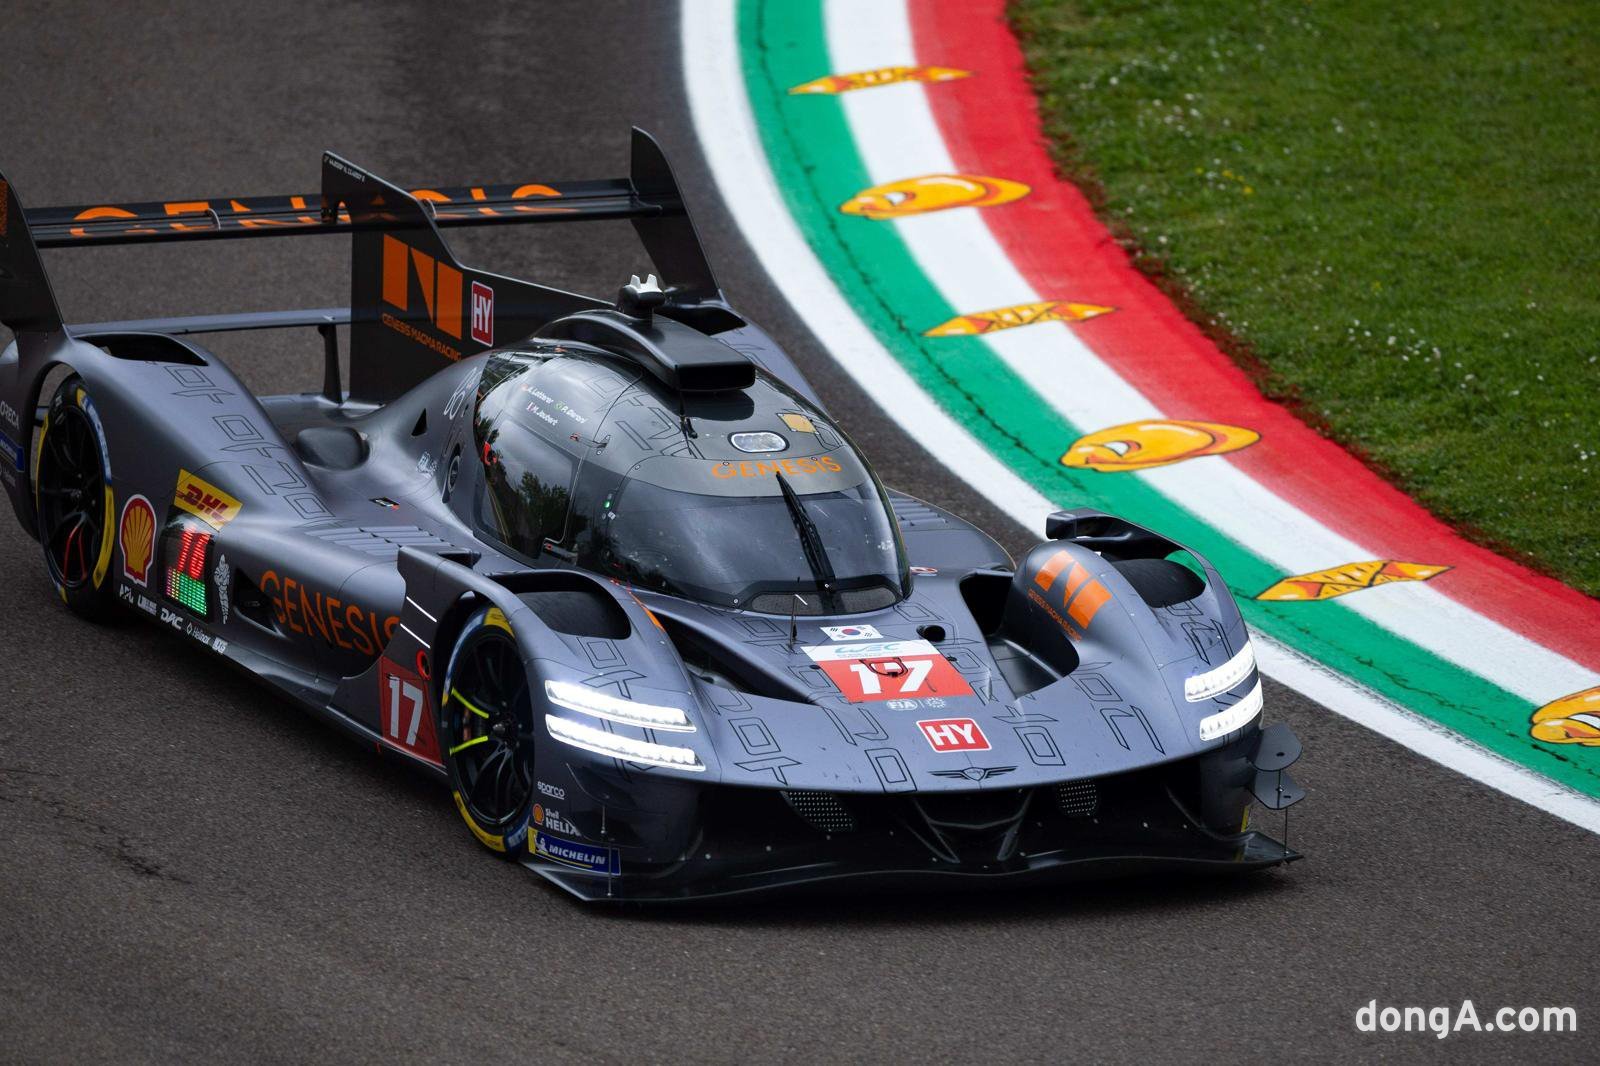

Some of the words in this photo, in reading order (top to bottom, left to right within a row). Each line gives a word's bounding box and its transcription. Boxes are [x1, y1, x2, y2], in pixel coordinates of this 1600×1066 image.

[473, 293, 491, 334] HY
[711, 456, 843, 479] GENESIS
[182, 483, 230, 522] DHL
[160, 607, 184, 631] DAC
[849, 659, 935, 695] 17
[389, 675, 424, 746] 17
[888, 700, 917, 711] FIA
[925, 723, 976, 746] HY
[537, 780, 565, 799] sparco
[545, 807, 560, 819] Shell
[546, 817, 582, 837] HELIX
[549, 844, 606, 865] MICHELIN
